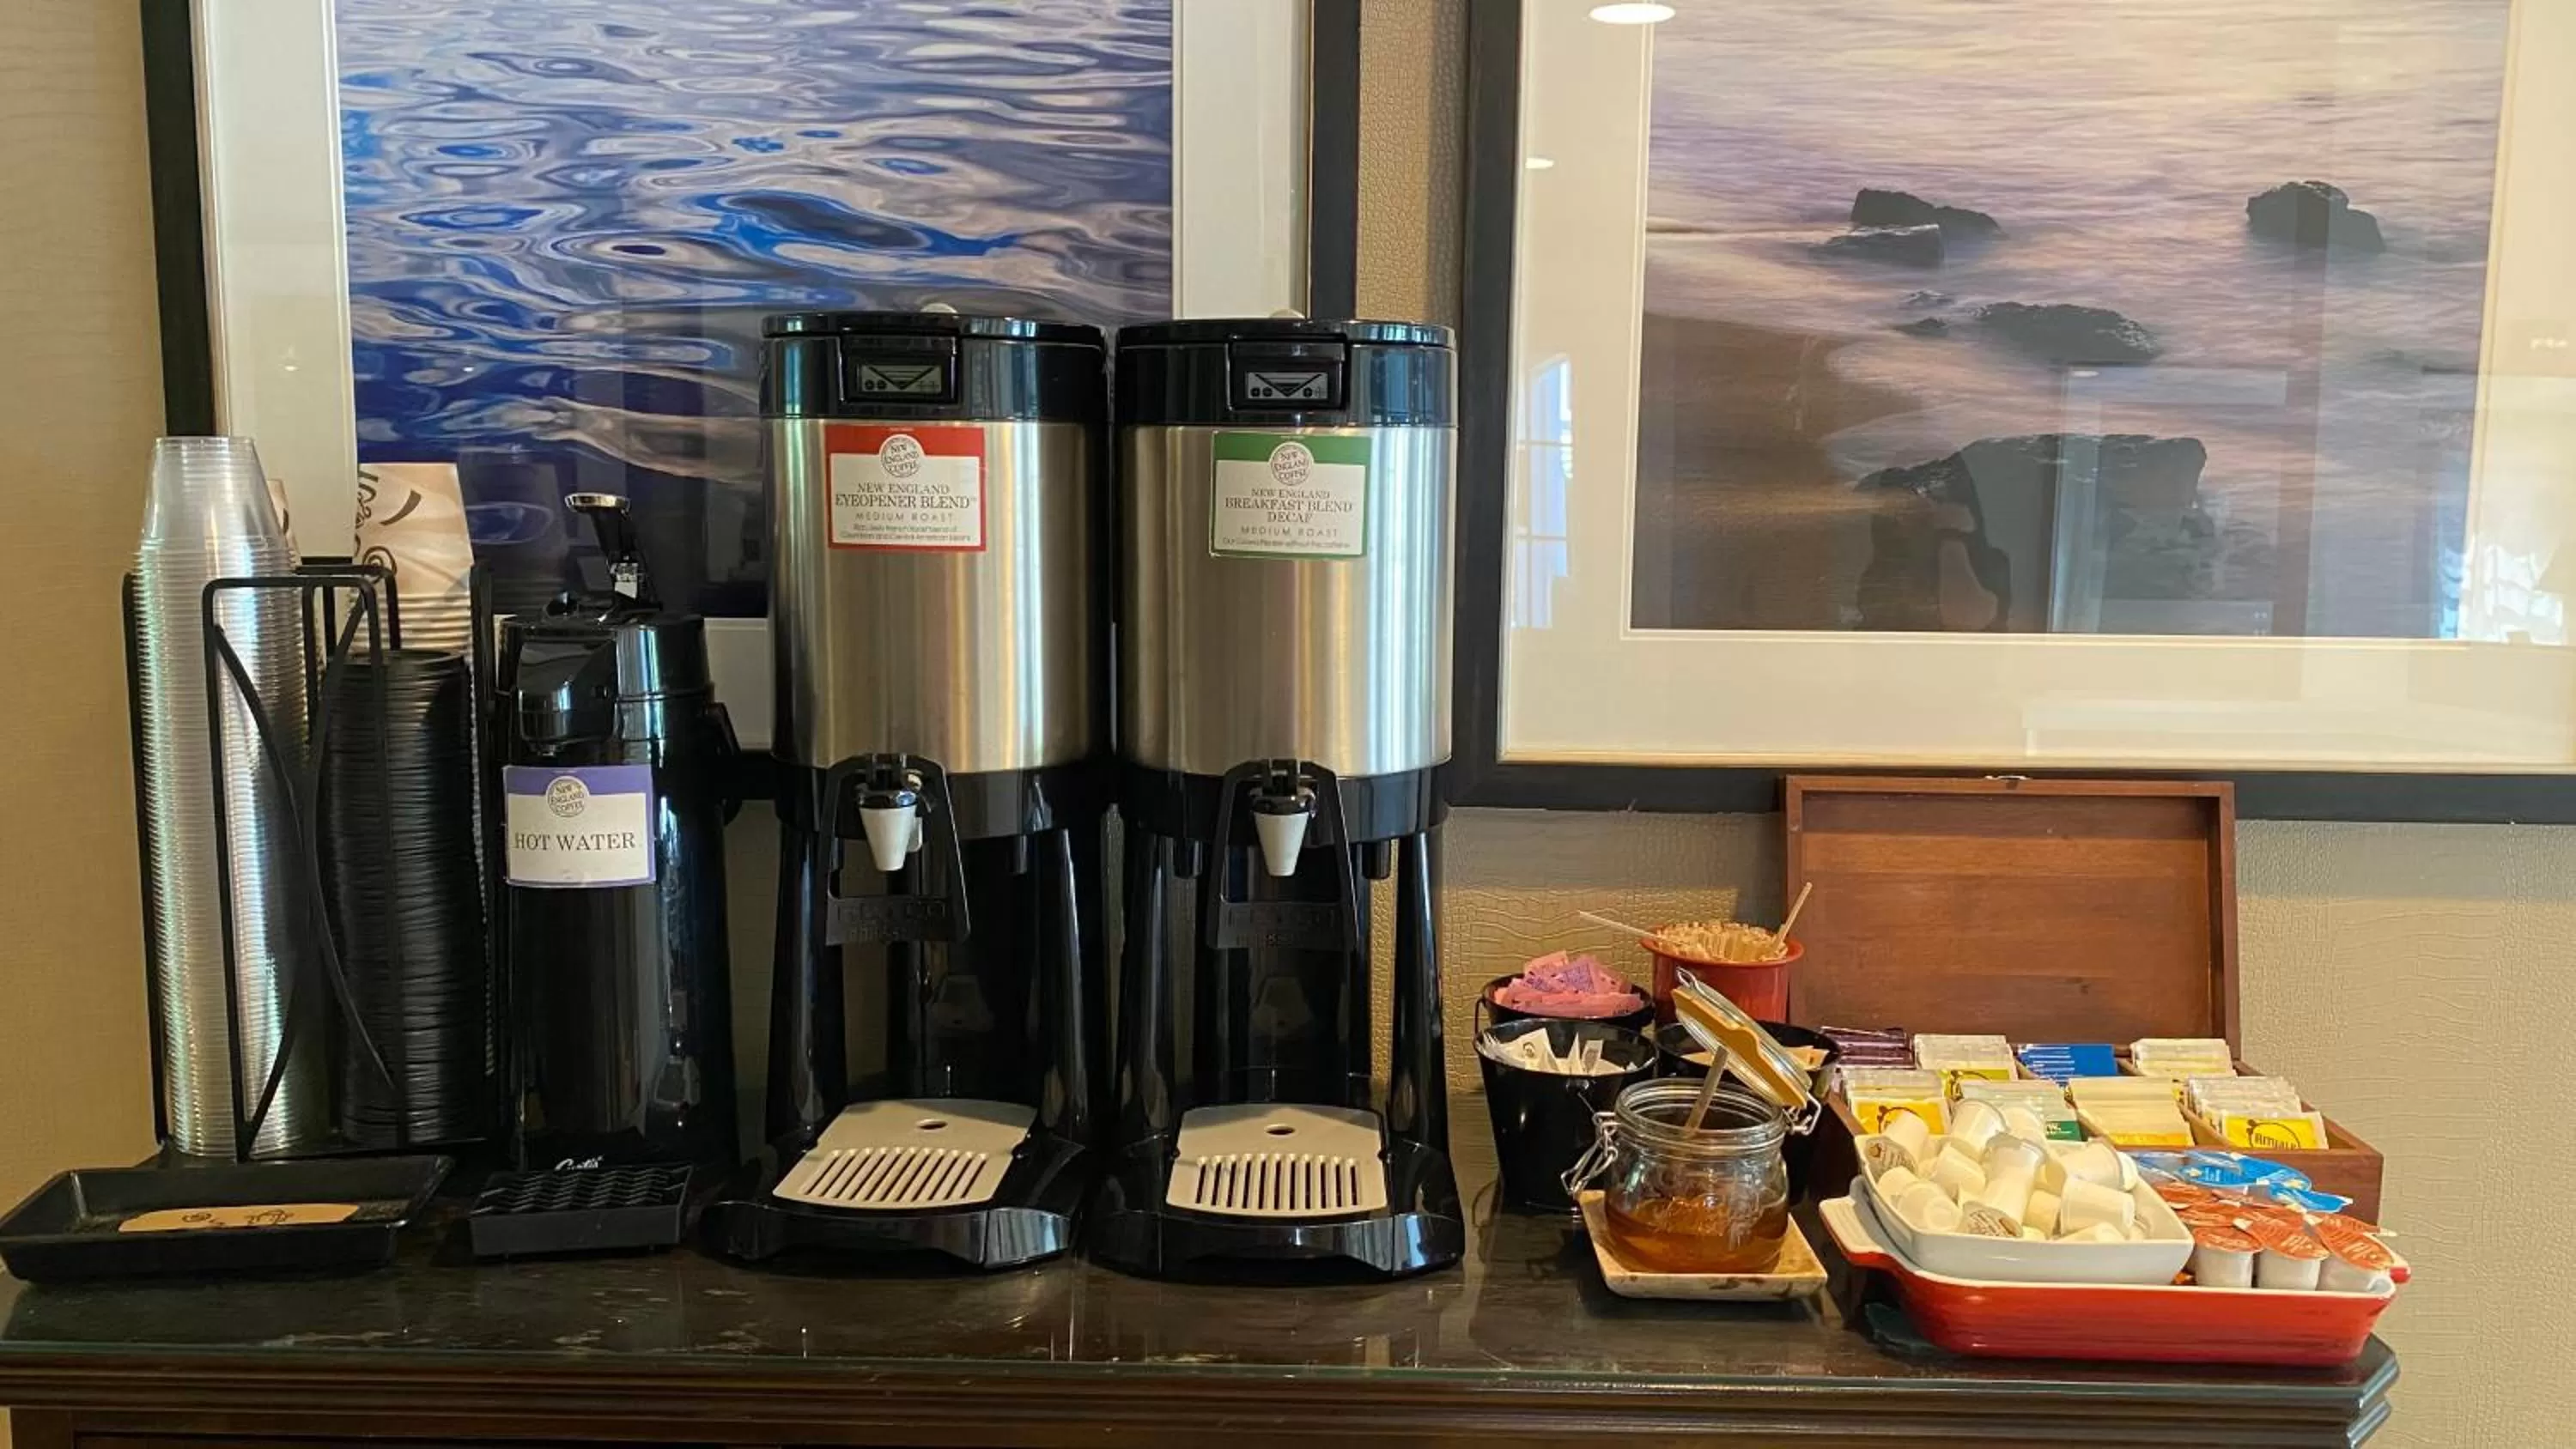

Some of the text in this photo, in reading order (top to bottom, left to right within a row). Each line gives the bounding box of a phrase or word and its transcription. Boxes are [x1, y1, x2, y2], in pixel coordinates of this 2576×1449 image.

[857, 482, 950, 494] NEW ENGLAND
[1251, 488, 1331, 499] NEW ENGLAND
[835, 494, 916, 508] EYEOPENER
[1225, 498, 1352, 513] BREAKFAST BLEND
[855, 512, 953, 522] MEDIUM ROAST
[1267, 512, 1314, 524] DECAF
[1241, 526, 1338, 537] MEDIUM ROAST
[514, 832, 636, 851] HOT WATER
